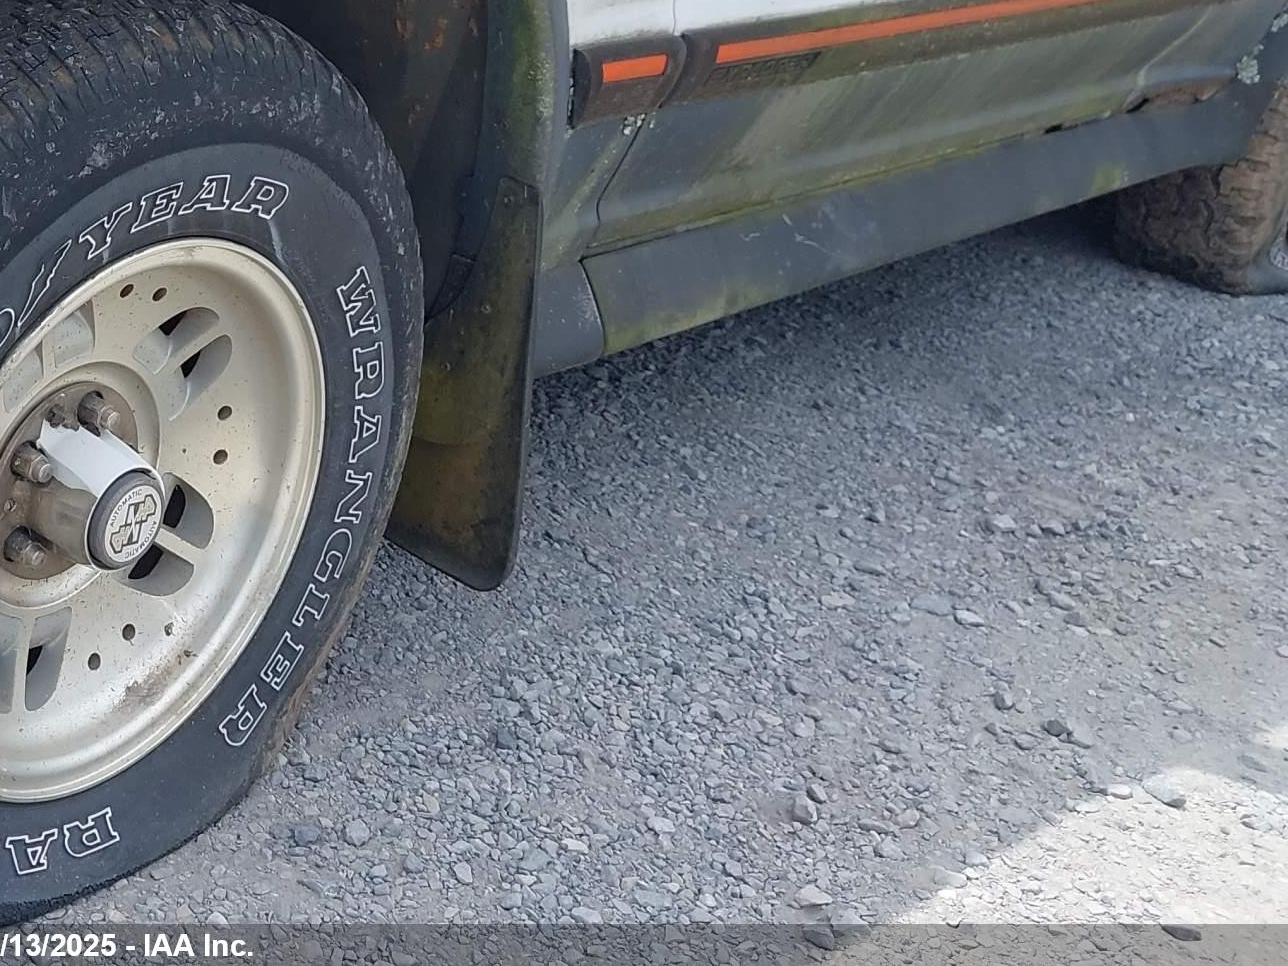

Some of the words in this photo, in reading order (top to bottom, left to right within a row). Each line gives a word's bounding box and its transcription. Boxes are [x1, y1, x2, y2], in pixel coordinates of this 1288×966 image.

[110, 488, 143, 528] AUTOMATIC
[220, 266, 387, 748] WRANGLER
[124, 520, 157, 559] AUTOMATIC
